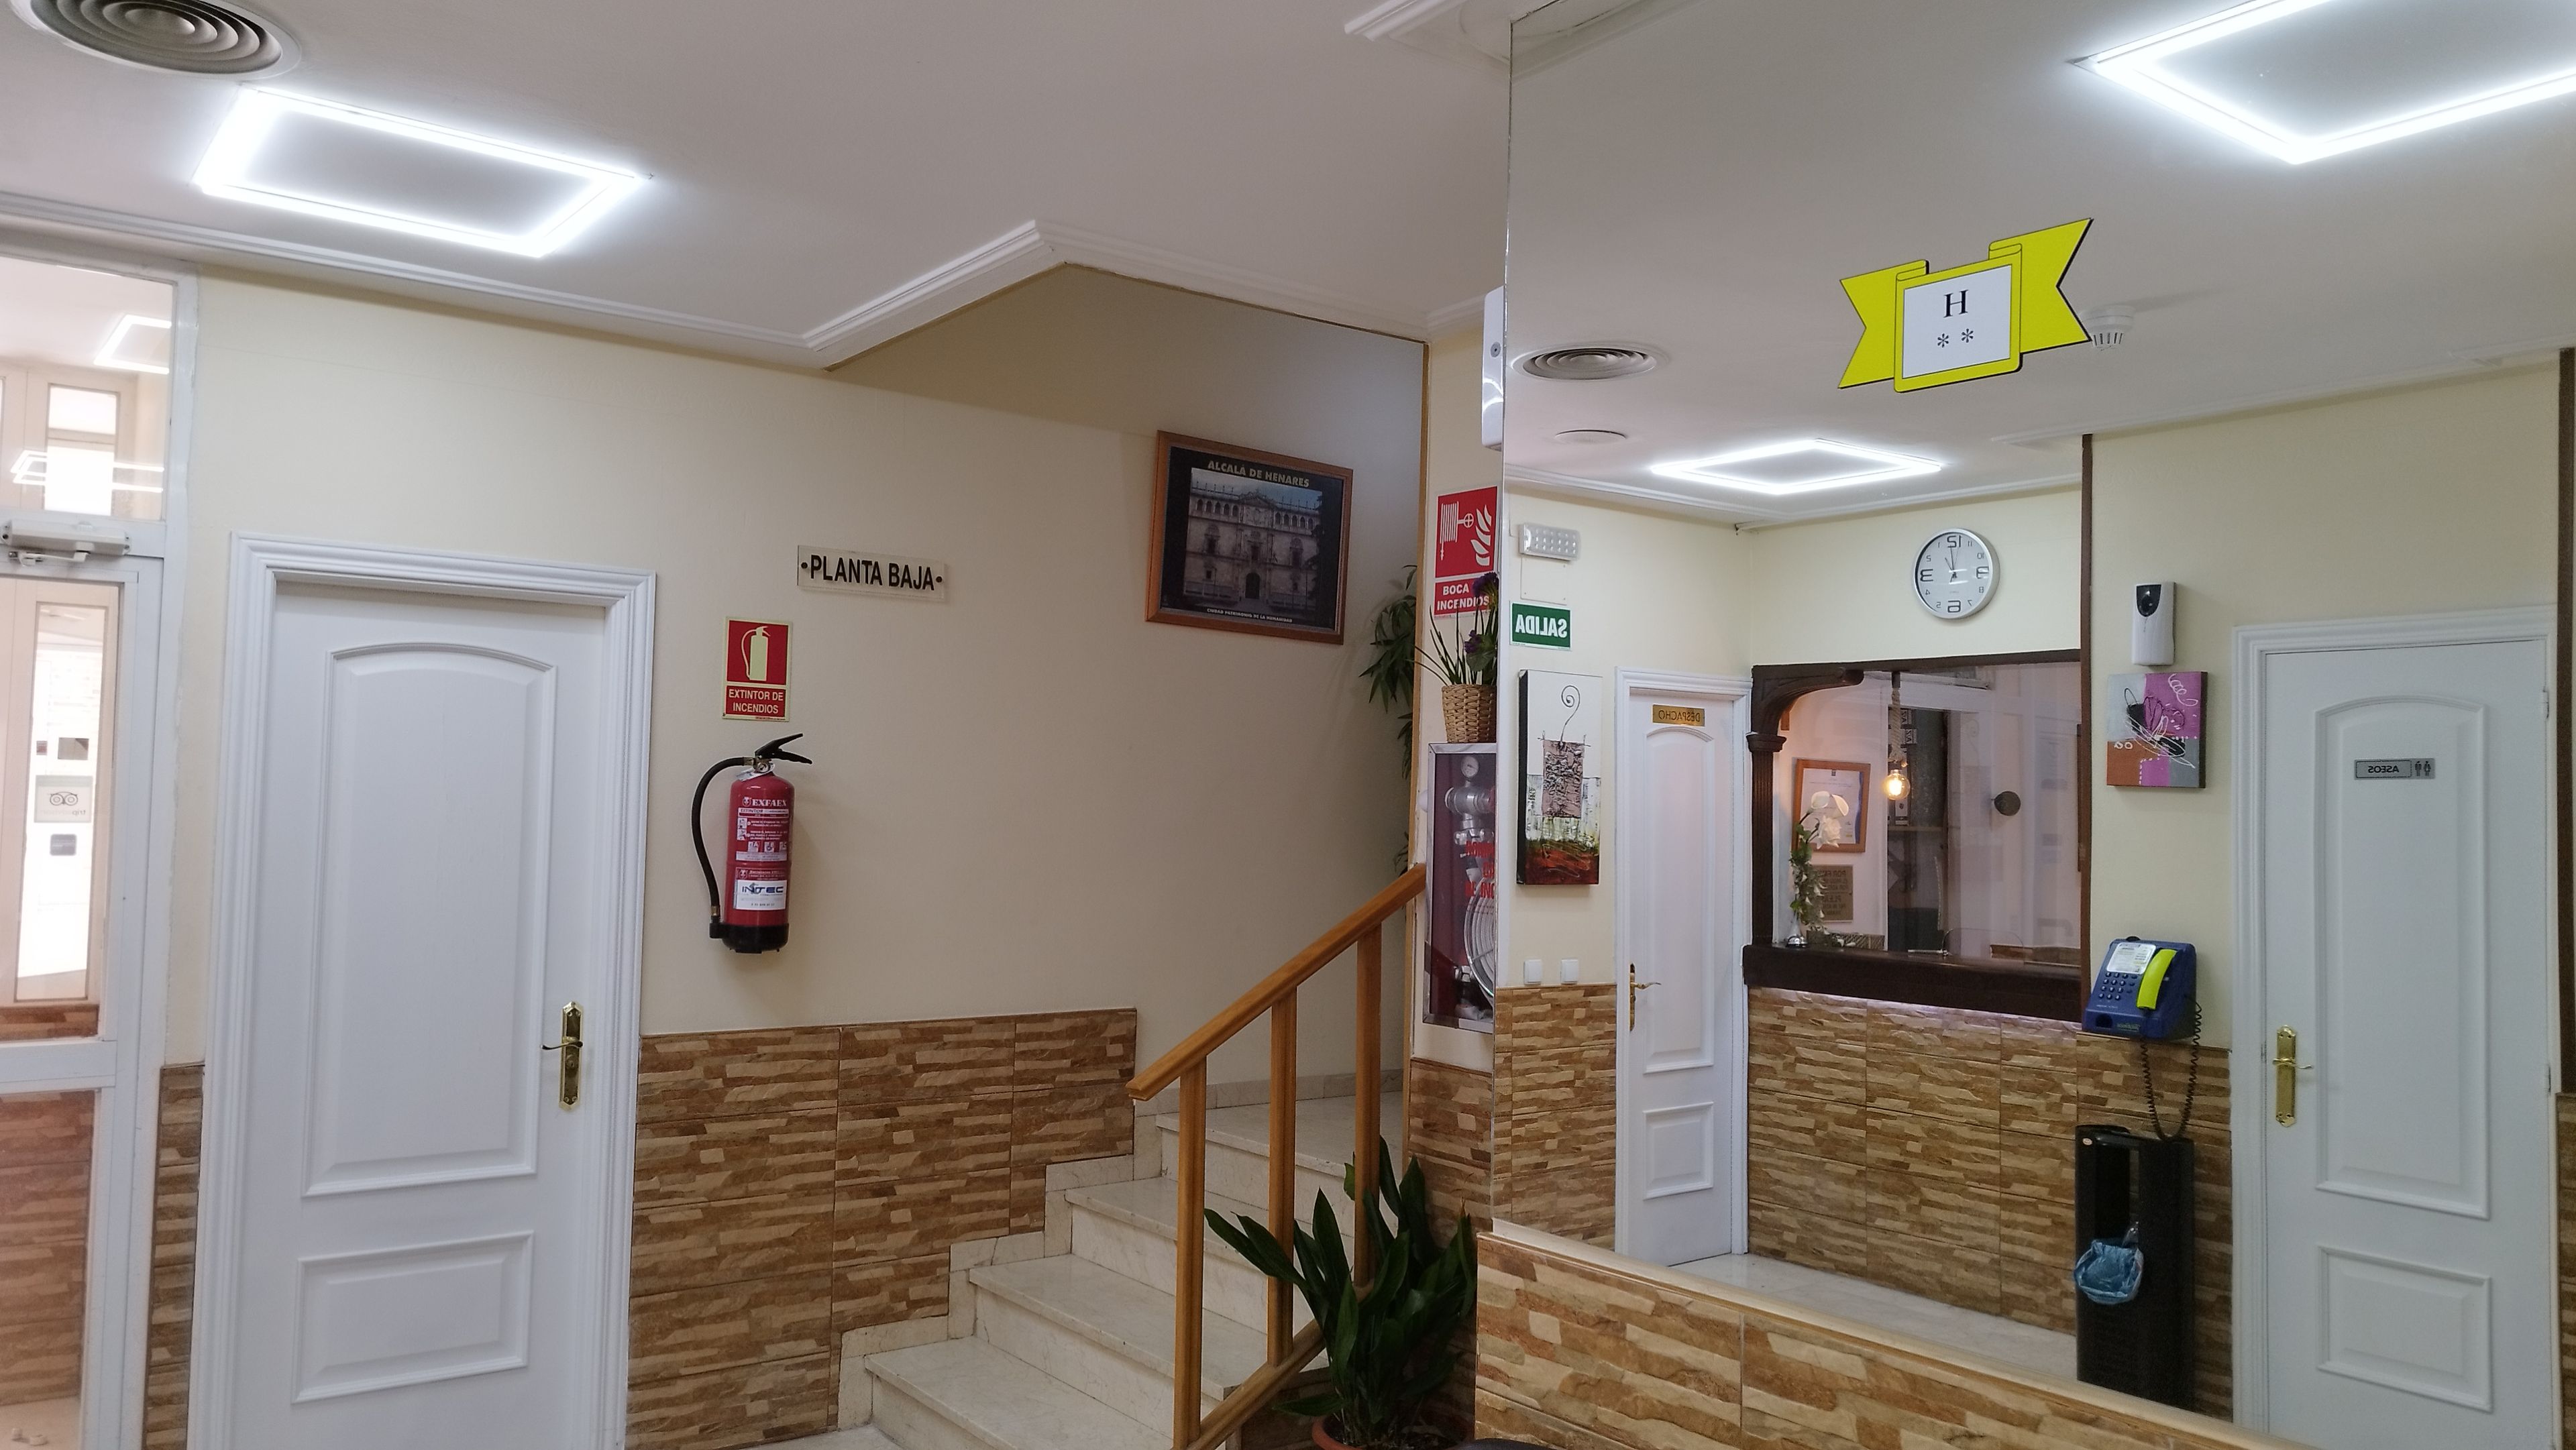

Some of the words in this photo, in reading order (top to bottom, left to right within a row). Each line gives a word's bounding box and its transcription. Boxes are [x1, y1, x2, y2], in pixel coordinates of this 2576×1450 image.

[1943, 290, 1969, 318] H
[1208, 460, 1246, 476] ALCALÁ
[1249, 468, 1263, 478] DE
[1265, 471, 1309, 488] HENARES
[810, 555, 883, 585] PLANTA
[888, 563, 934, 590] BAJA
[1442, 583, 1470, 596] BOCA
[1437, 596, 1489, 611] INCENDIOS
[729, 689, 770, 700] EXTINTOR
[772, 691, 784, 701] DE
[733, 702, 778, 714] INCENDIOS
[752, 798, 788, 807] EXFAEX
